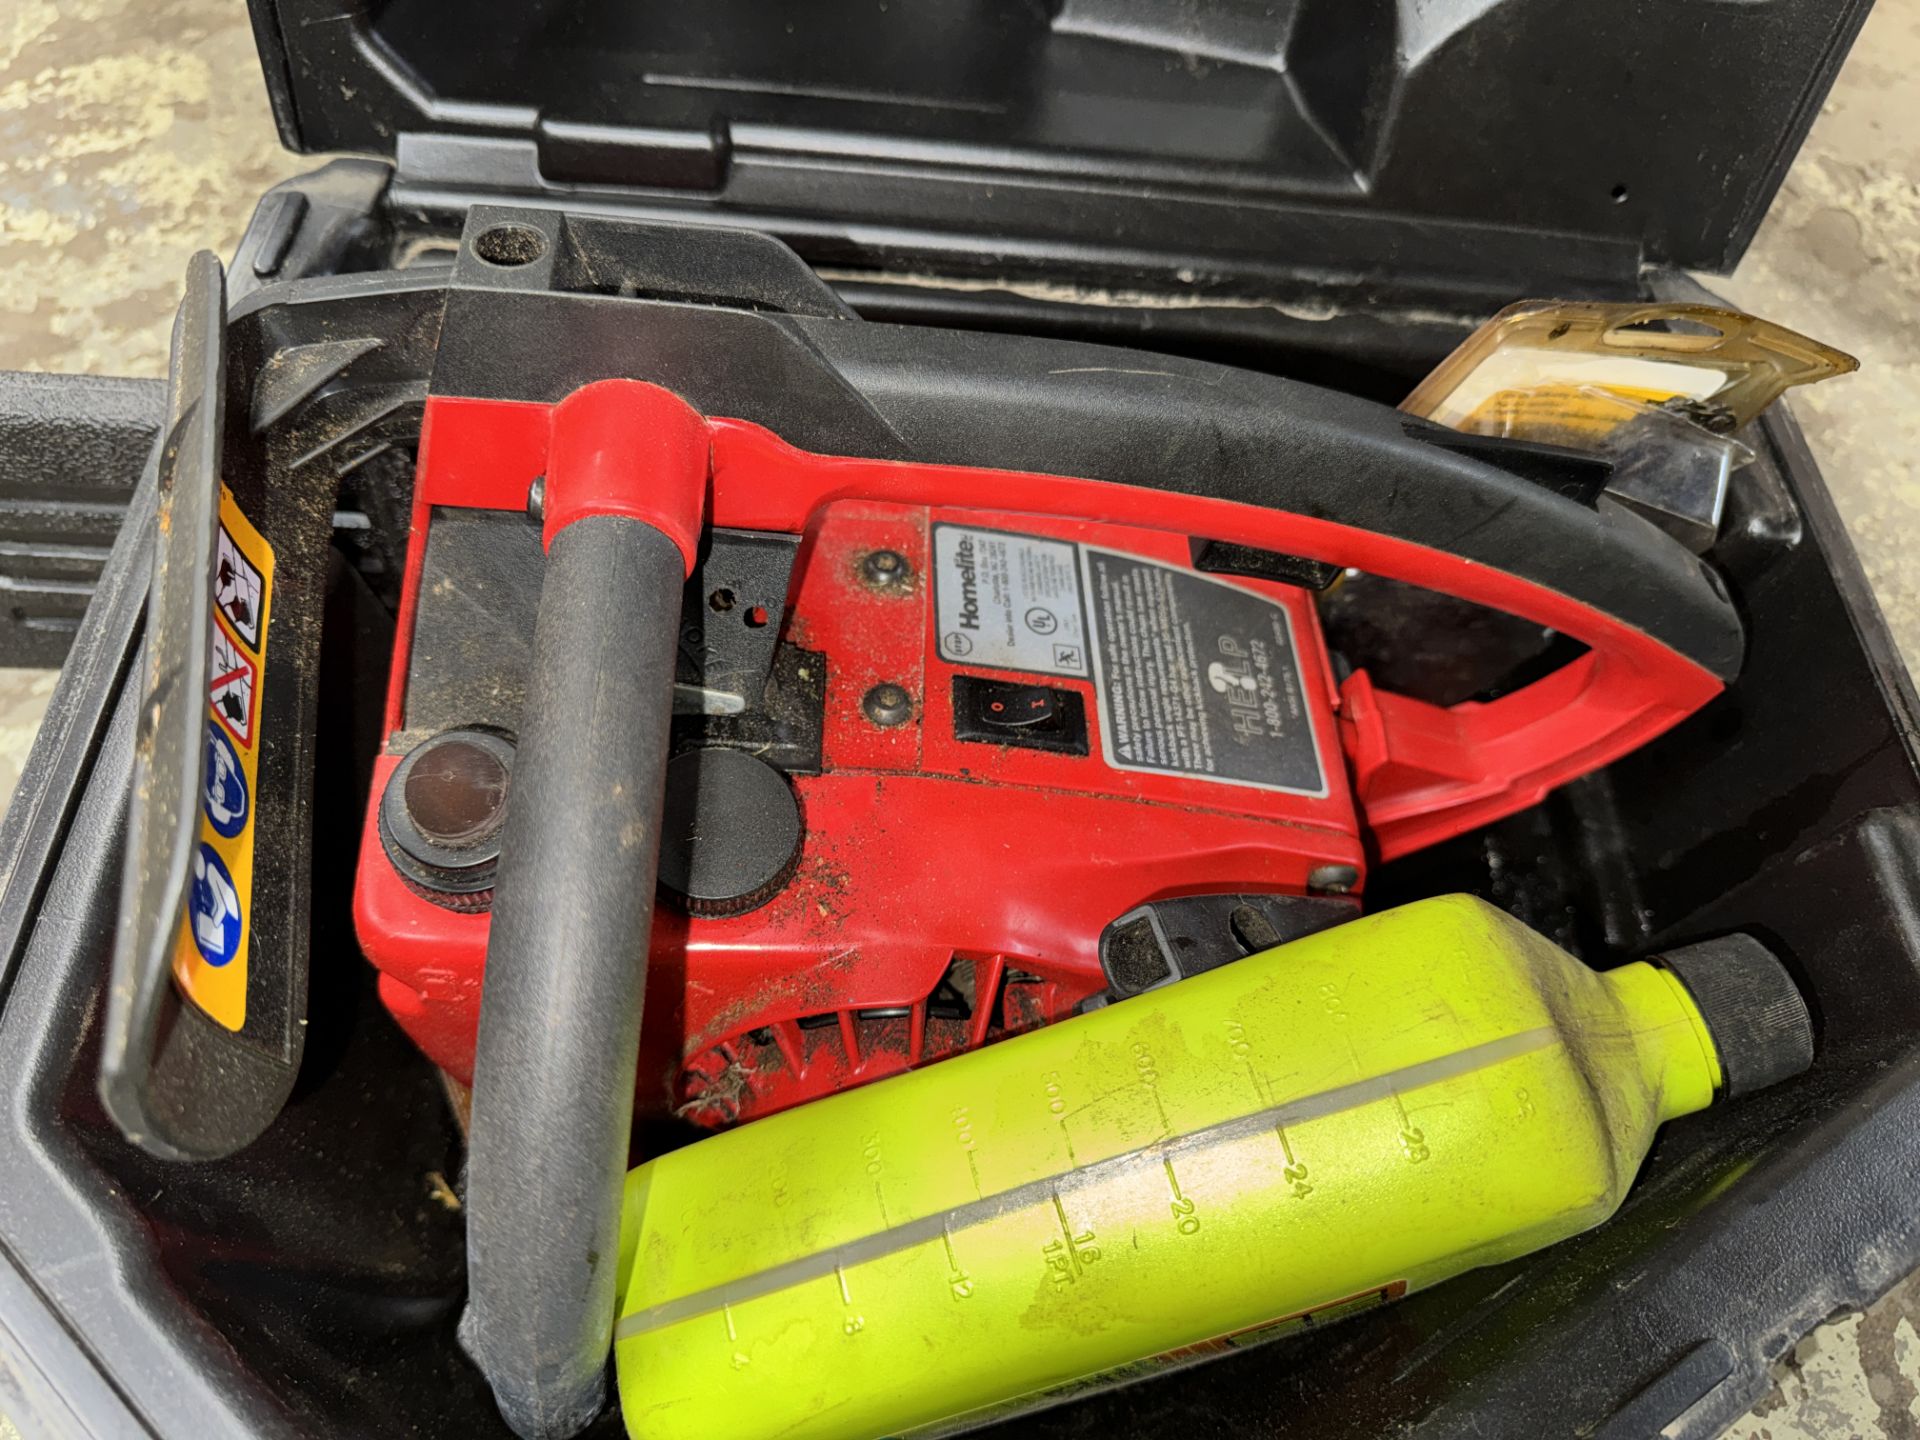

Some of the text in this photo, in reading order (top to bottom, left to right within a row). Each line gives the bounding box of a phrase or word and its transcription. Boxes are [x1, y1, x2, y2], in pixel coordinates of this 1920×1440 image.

[952, 539, 980, 630] Homelite
[1102, 600, 1116, 642] operation
[1136, 596, 1146, 613] saw
[1126, 611, 1137, 635] could
[1138, 614, 1150, 638] chain
[1108, 644, 1118, 663] safe
[1121, 651, 1131, 665] the
[1130, 636, 1145, 688] instructions
[1142, 639, 1153, 658] This
[1110, 664, 1121, 680] For
[1191, 670, 1205, 710] kickback
[1218, 634, 1263, 735] HELP
[1250, 639, 1283, 739] 1-800-242-4672
[1111, 681, 1129, 744] WARNING:
[1125, 676, 1140, 732] precautions
[1138, 689, 1149, 718] follow
[1149, 688, 1163, 729] personal
[1162, 697, 1173, 723] angle
[1142, 719, 1151, 730] to
[1198, 711, 1213, 757] achieving
[1132, 732, 1144, 762] safety
[1143, 730, 1156, 764] Failure
[1156, 730, 1169, 766] serious
[1166, 723, 1180, 767] kickback
[1182, 747, 1193, 769] with
[1205, 758, 1215, 772] for
[1221, 1018, 1251, 1059] 700
[1130, 1041, 1158, 1088] 600
[1399, 1126, 1430, 1165] 28
[1283, 1162, 1313, 1200] 24
[1170, 1199, 1201, 1237] 20
[1074, 1229, 1102, 1265] 16
[949, 1270, 974, 1302] 12
[843, 1315, 865, 1336] 8
